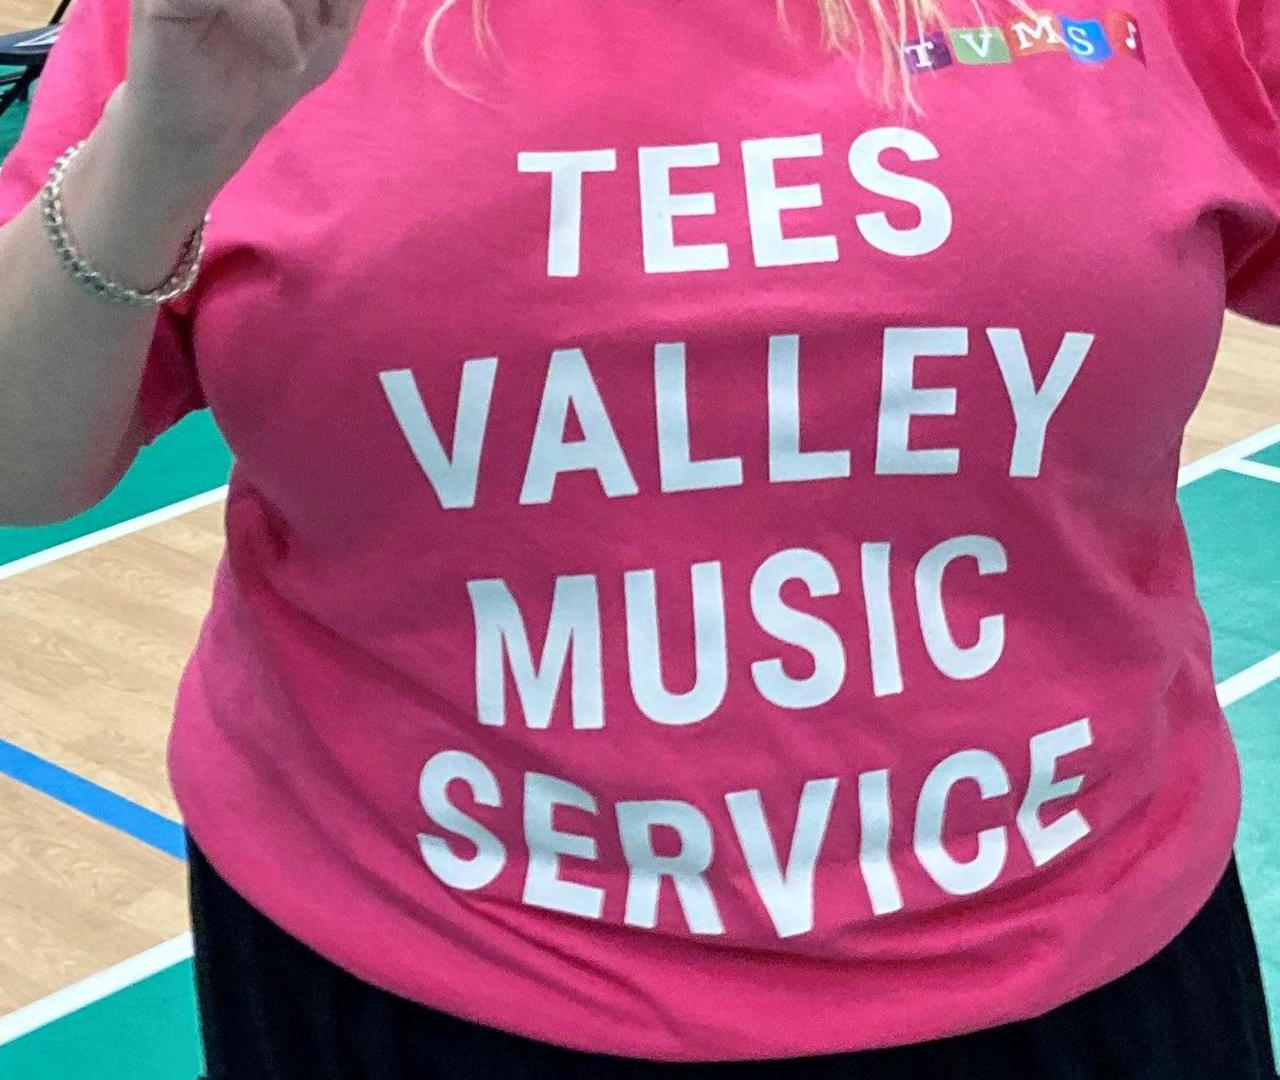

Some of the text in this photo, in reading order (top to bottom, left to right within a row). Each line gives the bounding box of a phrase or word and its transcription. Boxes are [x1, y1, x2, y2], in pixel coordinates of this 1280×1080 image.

[903, 15, 1095, 68] TVMS
[517, 126, 953, 278] TEES
[378, 326, 1096, 510] VALLEY
[465, 534, 1008, 730] MUSIC
[416, 717, 1094, 940] SERVICE
